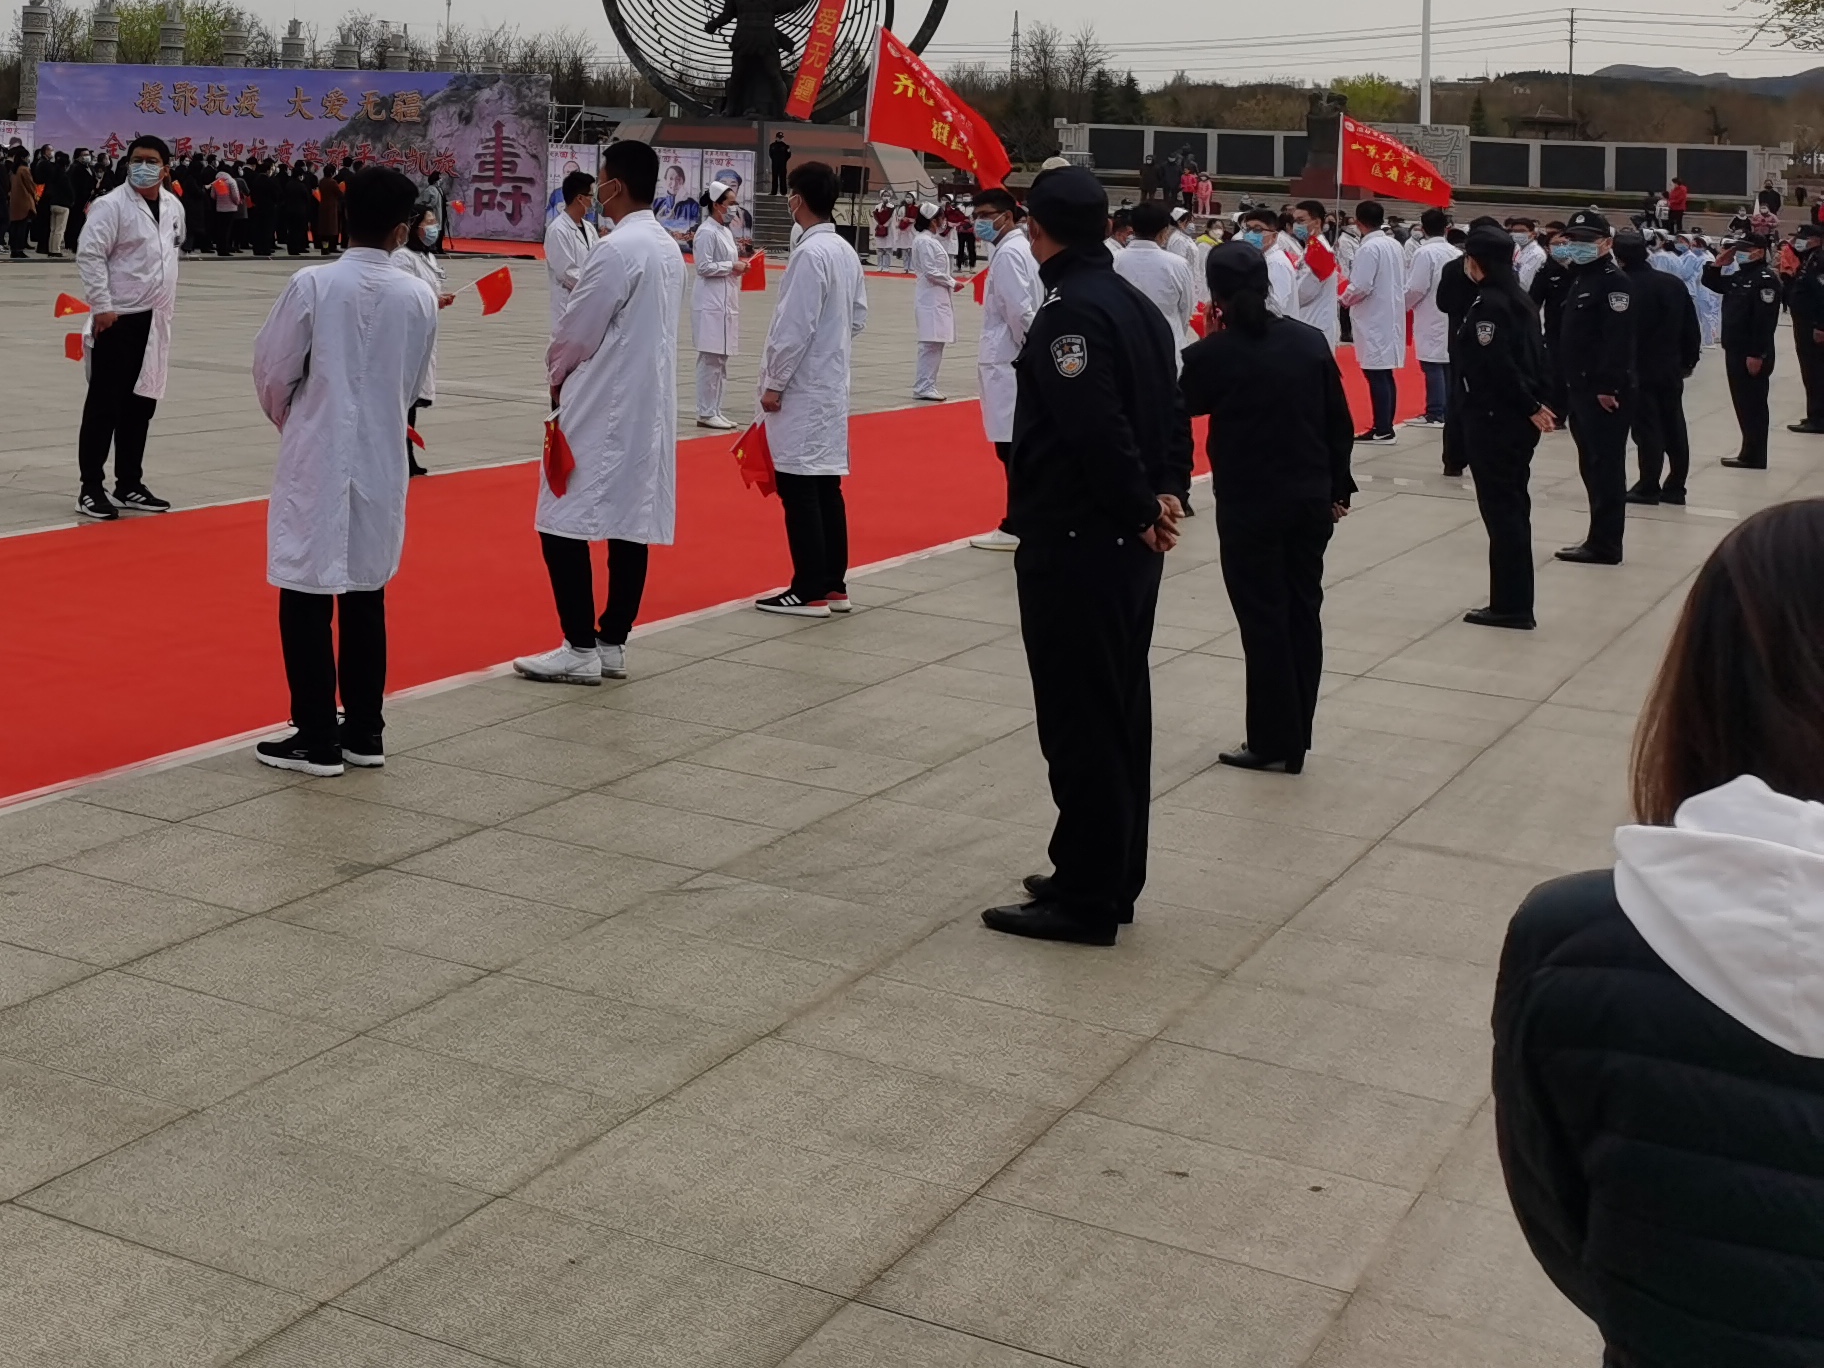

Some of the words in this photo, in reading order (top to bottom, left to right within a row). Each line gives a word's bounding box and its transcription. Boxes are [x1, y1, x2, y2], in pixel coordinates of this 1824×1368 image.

[133, 82, 264, 118] 援鄂抗疫
[285, 86, 426, 124] 大爱无疆
[100, 131, 460, 178] 全民欢迎抗疫英雄平安凯旋
